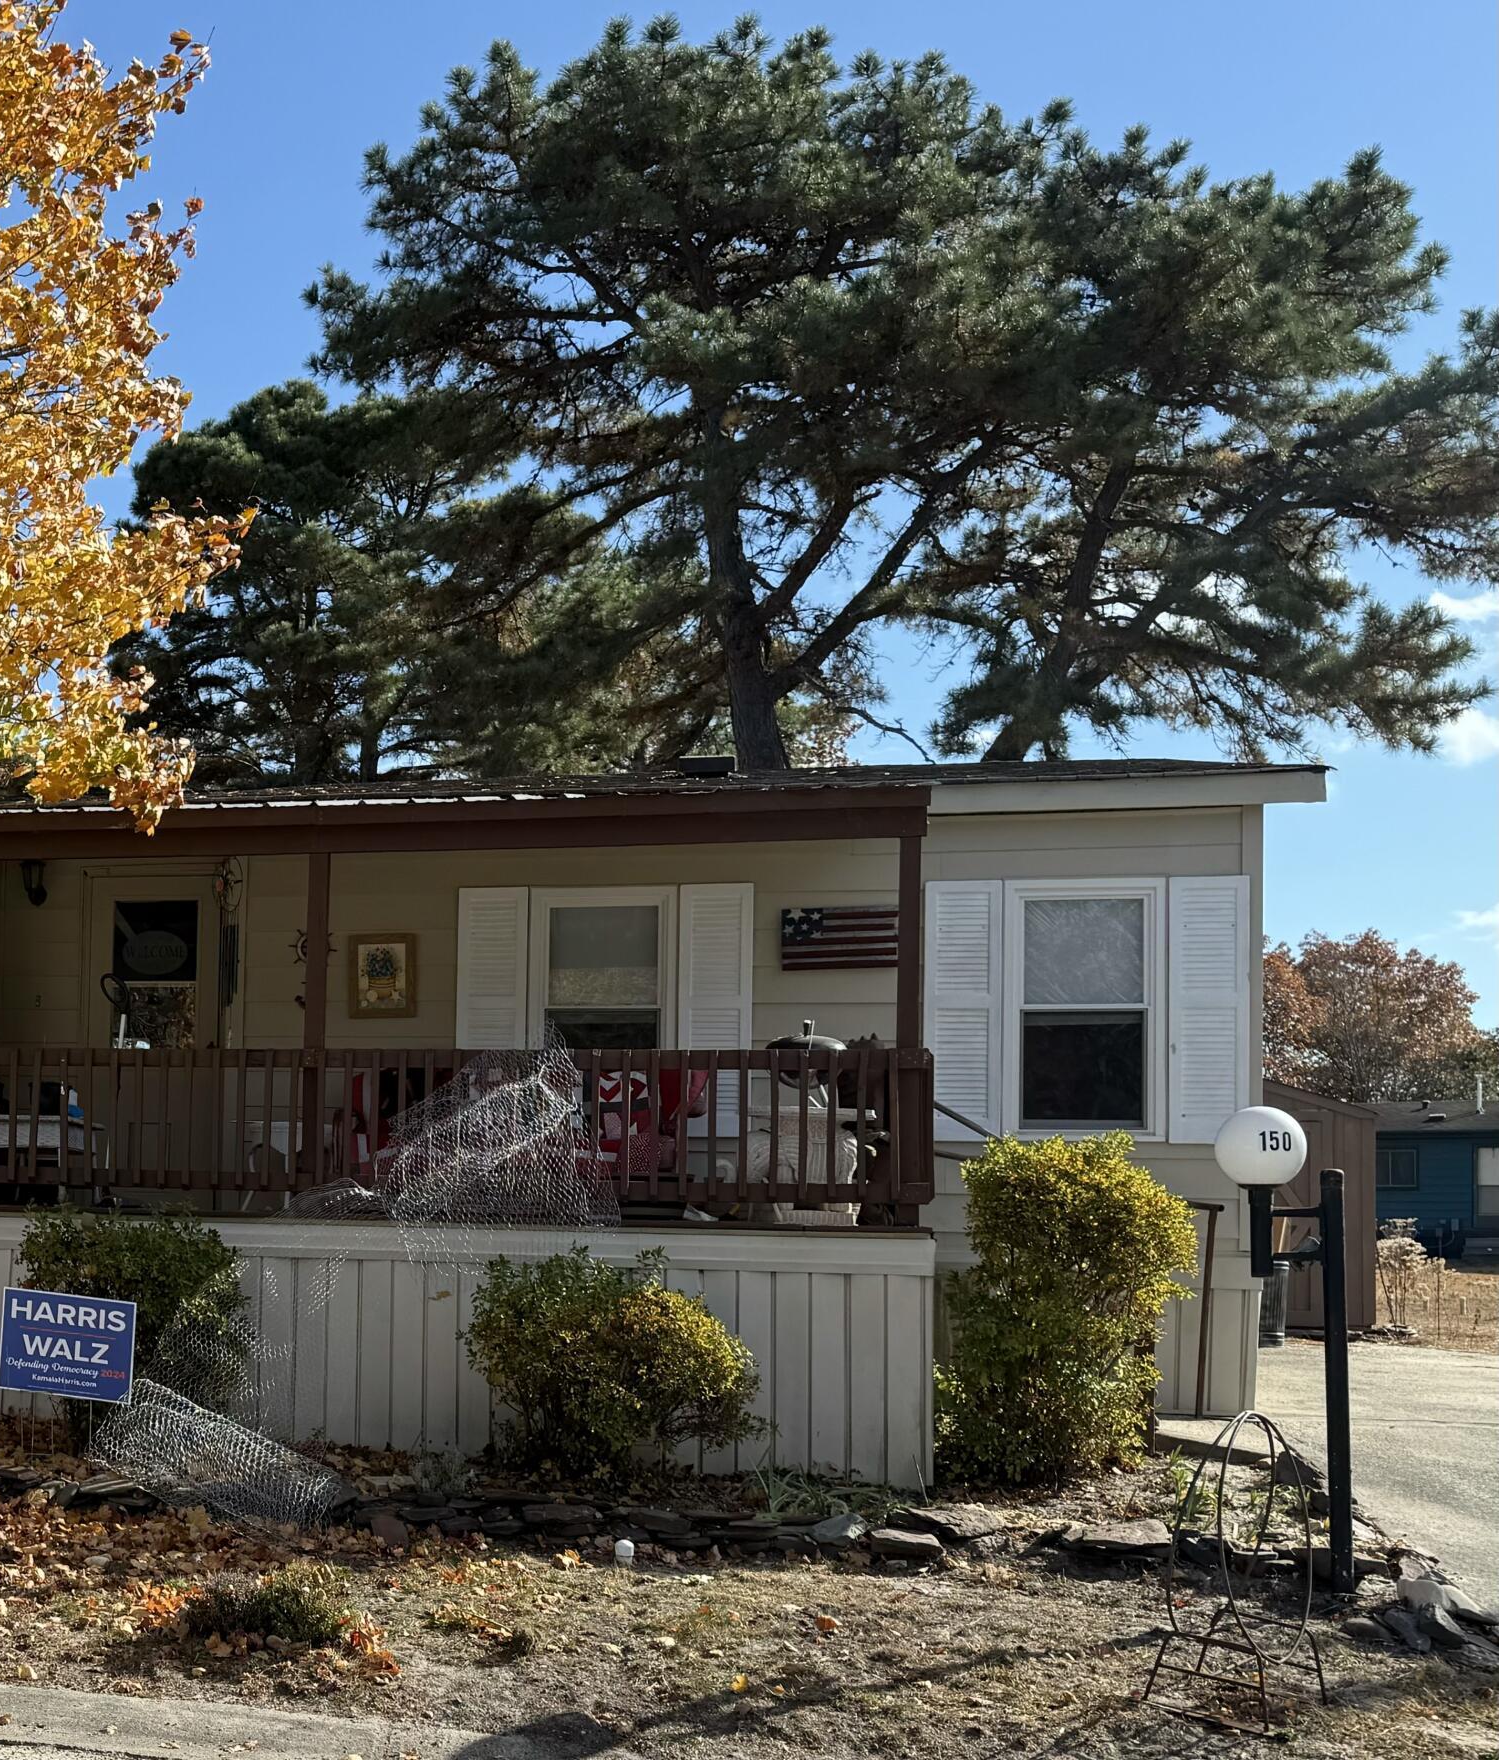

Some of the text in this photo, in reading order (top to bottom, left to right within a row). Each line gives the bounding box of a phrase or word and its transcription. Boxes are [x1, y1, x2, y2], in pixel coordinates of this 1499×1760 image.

[124, 944, 185, 960] WELCOME
[1259, 1130, 1292, 1152] 150
[10, 1298, 126, 1332] HARRIS
[22, 1333, 109, 1365] WALZ
[5, 1356, 125, 1379] Defending Democracy 2024
[32, 1373, 97, 1388] KamalaHarris.com
